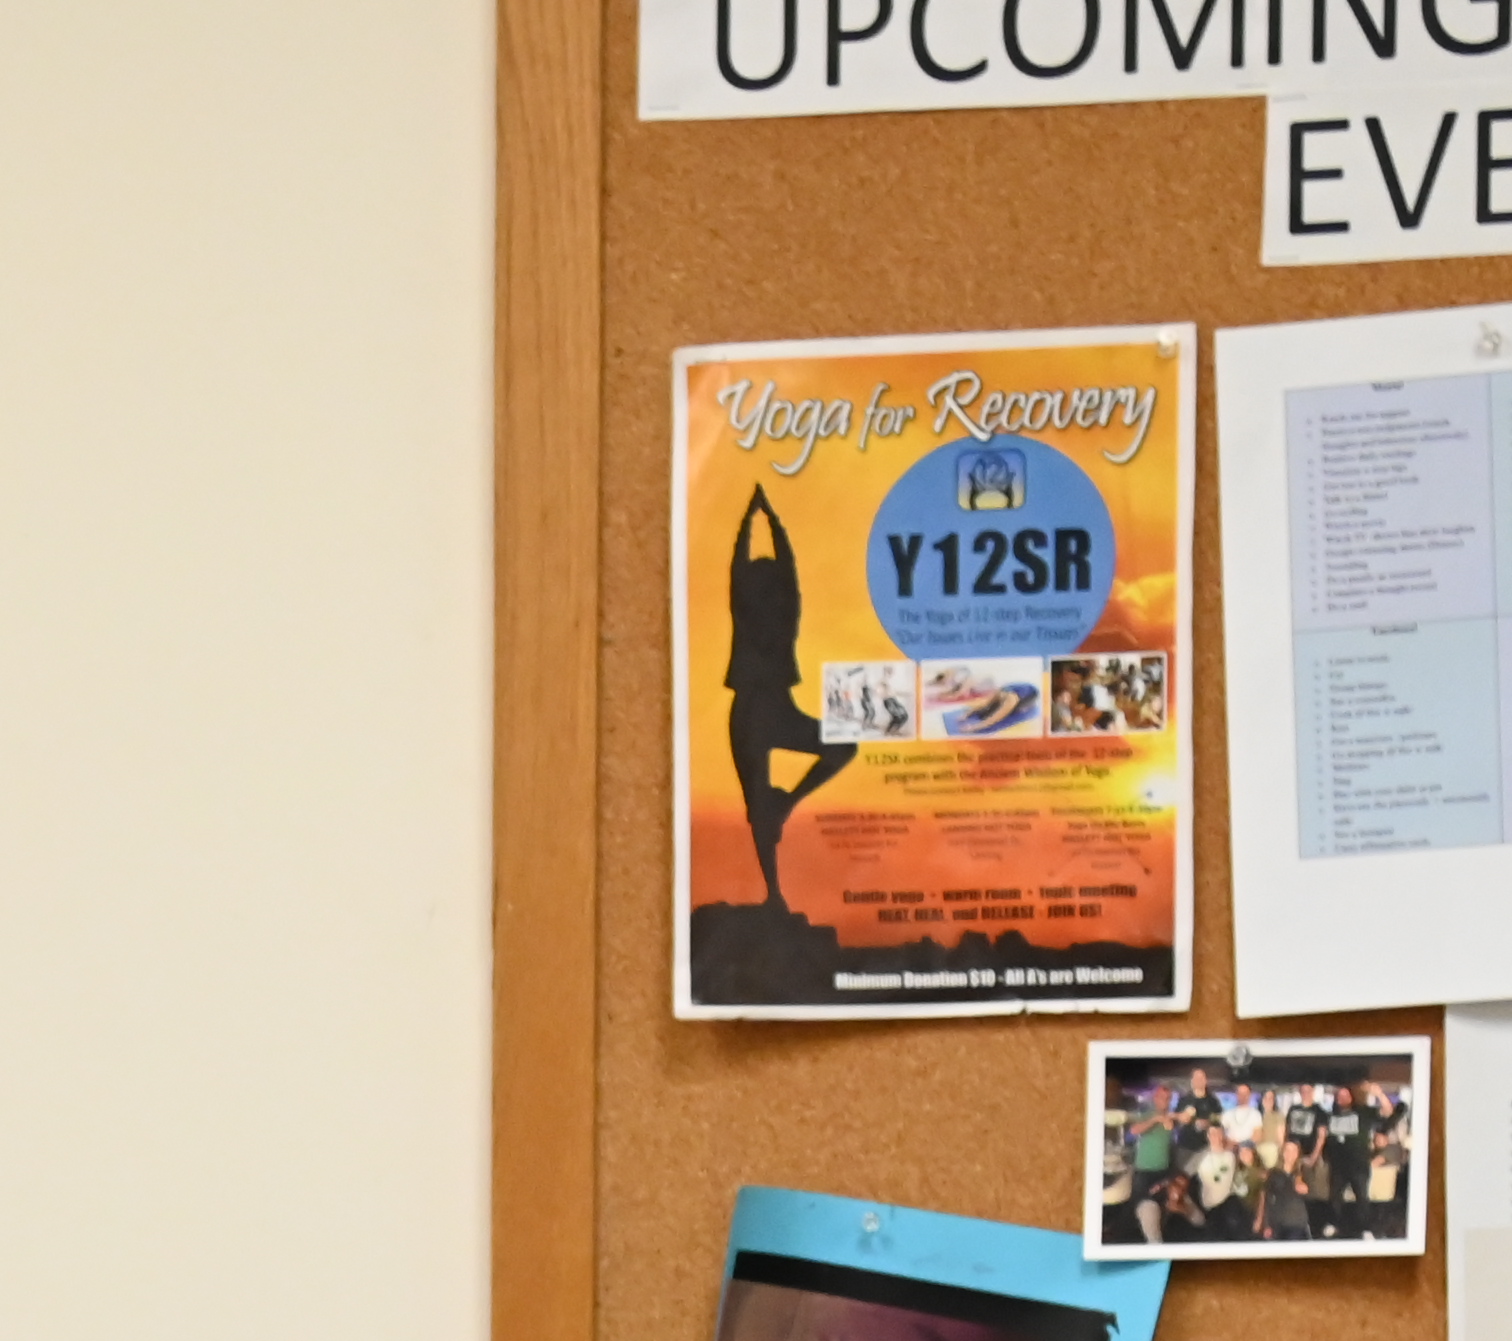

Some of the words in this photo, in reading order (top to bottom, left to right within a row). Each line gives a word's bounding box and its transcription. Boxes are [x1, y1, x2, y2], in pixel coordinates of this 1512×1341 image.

[717, 378, 850, 476] Yoga
[858, 382, 914, 450] for
[926, 369, 1156, 465] Recovery
[887, 526, 1091, 598] Y12SR
[834, 971, 902, 990] Minimum
[904, 969, 968, 989] Donation
[1049, 968, 1074, 985] are
[1076, 966, 1144, 985] Welcome
